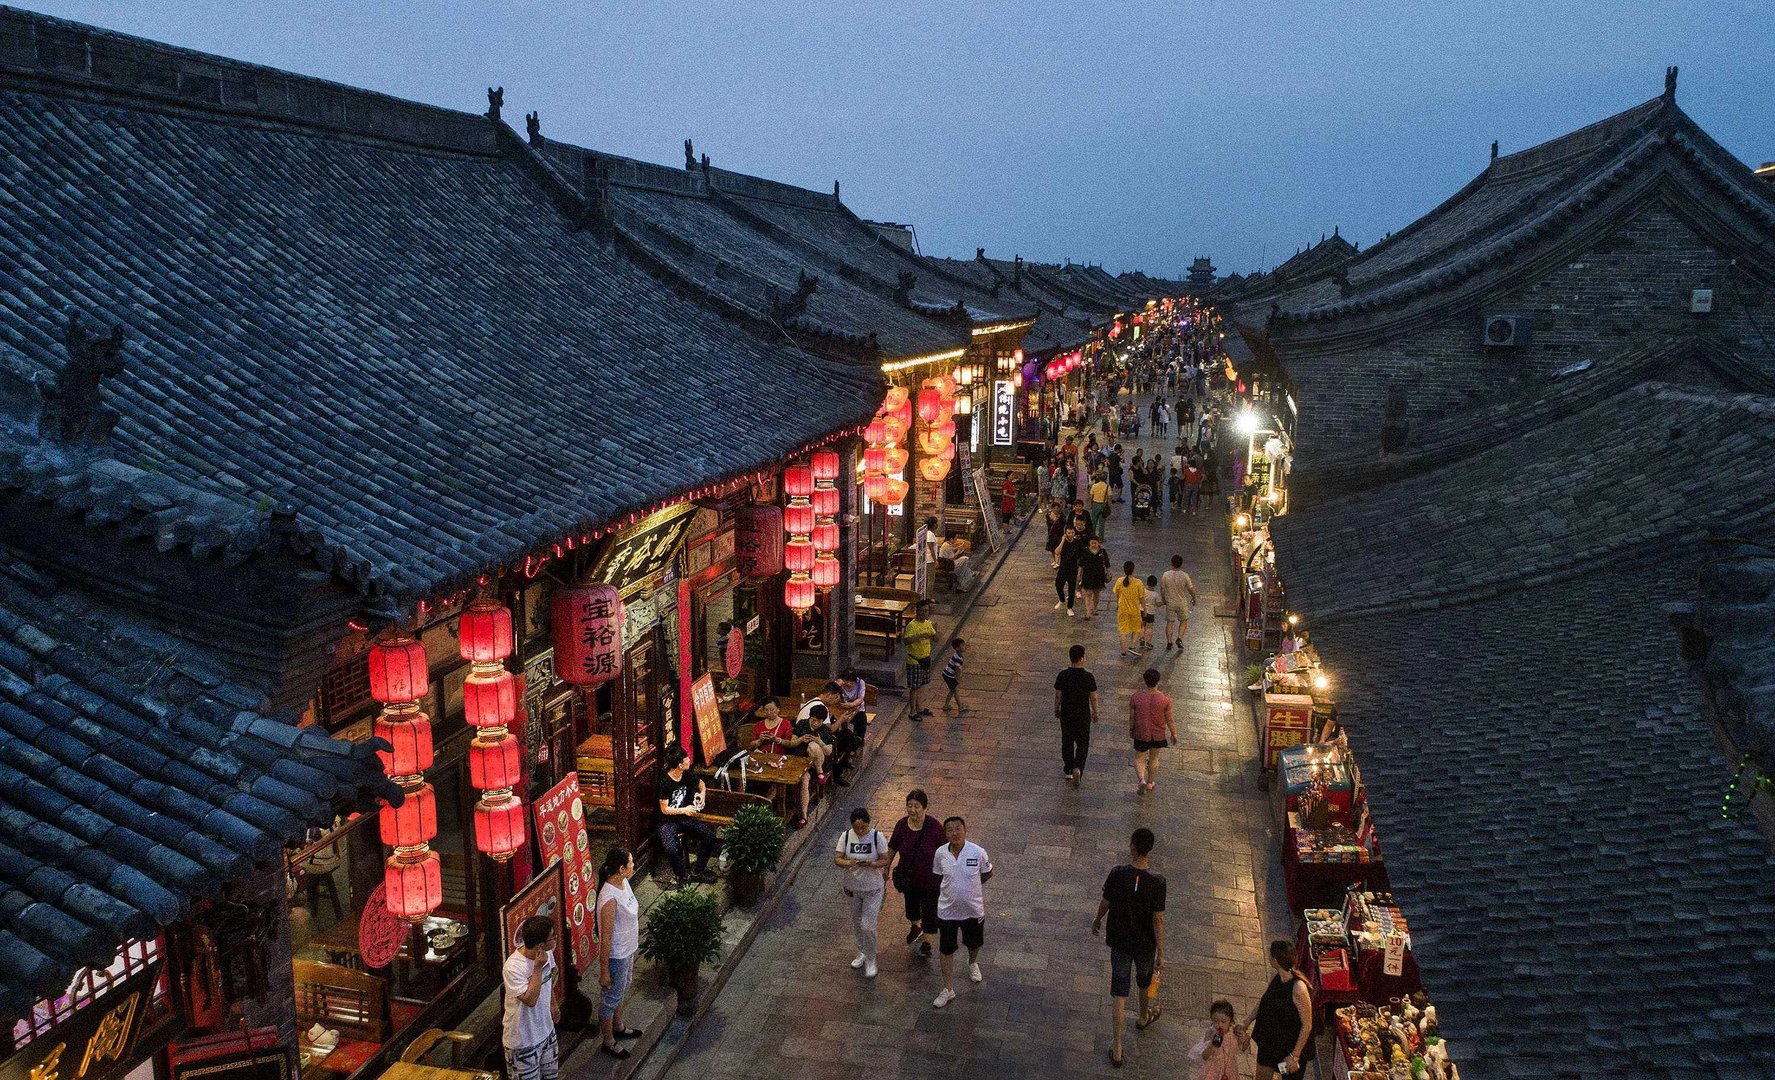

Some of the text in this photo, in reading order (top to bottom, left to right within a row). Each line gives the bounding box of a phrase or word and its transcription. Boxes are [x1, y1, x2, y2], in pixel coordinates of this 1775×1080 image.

[539, 780, 579, 818] 平遥地方小吃
